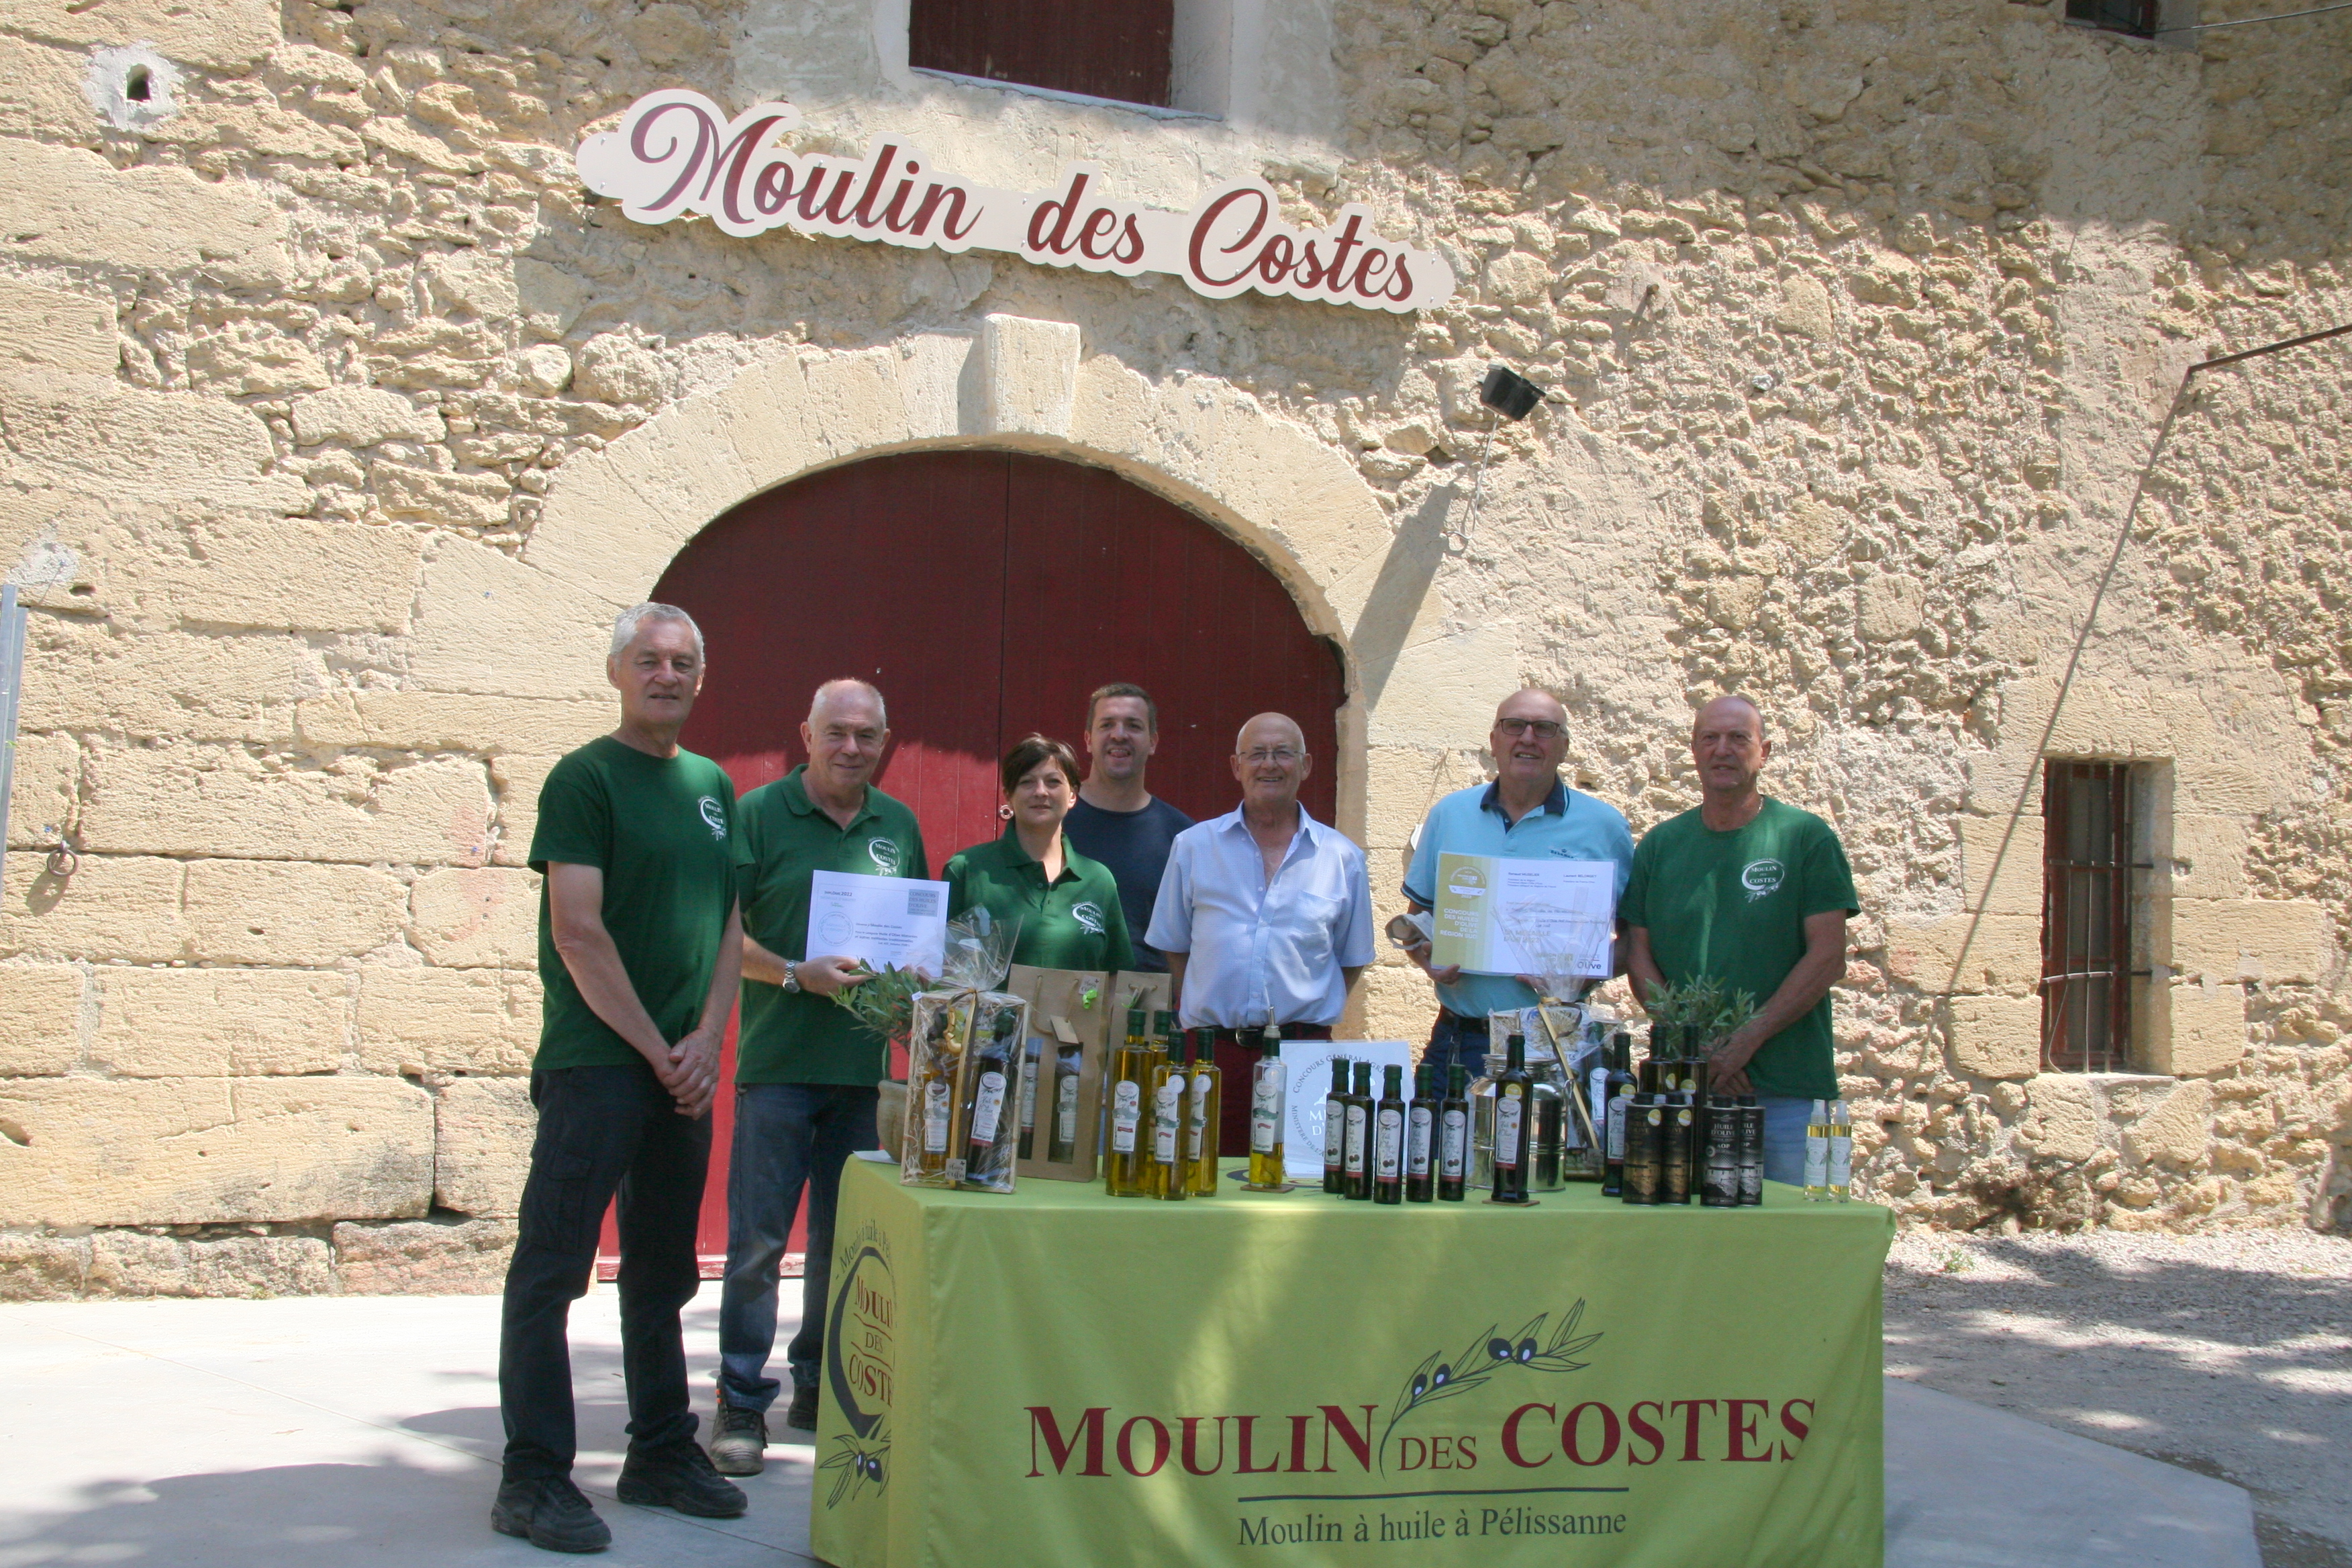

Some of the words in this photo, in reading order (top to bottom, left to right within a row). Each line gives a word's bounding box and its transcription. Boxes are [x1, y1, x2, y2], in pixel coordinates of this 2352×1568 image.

[630, 101, 983, 241] Moulin
[1026, 173, 1144, 264] des
[1188, 188, 1414, 303] Costes
[1444, 908, 1479, 916] CONCOURS
[1293, 1059, 1324, 1093] CONCOURS
[865, 1332, 883, 1353] DES
[849, 1353, 892, 1408] COSTE
[1024, 1405, 1379, 1477] MOULIN
[1397, 1436, 1477, 1471] DES
[1501, 1398, 1815, 1468] COSTES
[1238, 1514, 1343, 1545] Moulin
[1353, 1514, 1369, 1542] à
[1379, 1510, 1446, 1542] huile
[1455, 1508, 1470, 1536] à
[1480, 1507, 1627, 1536] Pélissanne
